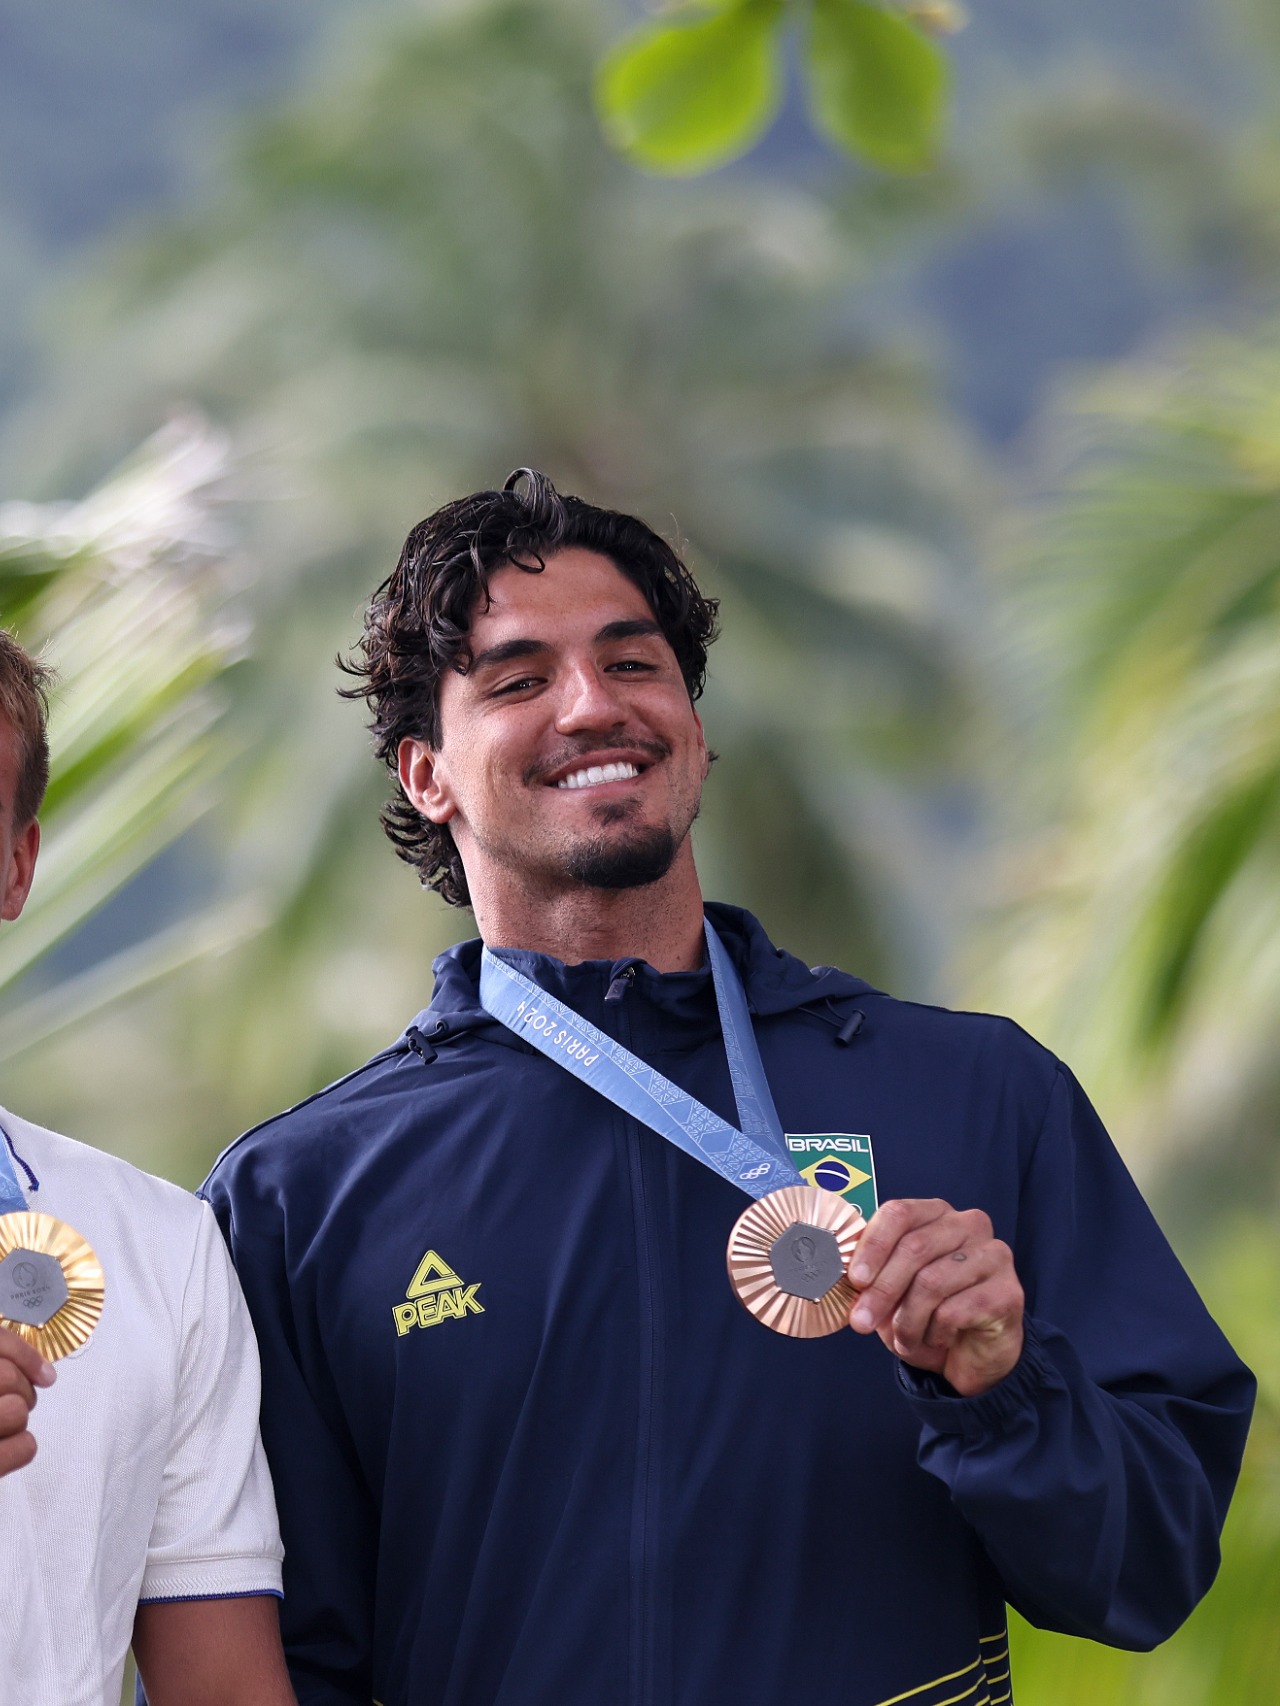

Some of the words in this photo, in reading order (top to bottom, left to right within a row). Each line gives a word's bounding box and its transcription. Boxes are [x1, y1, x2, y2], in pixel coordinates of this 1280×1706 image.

[516, 1000, 557, 1036] 2024
[788, 1138, 869, 1153] BRASIL
[392, 1282, 486, 1337] PEAK
